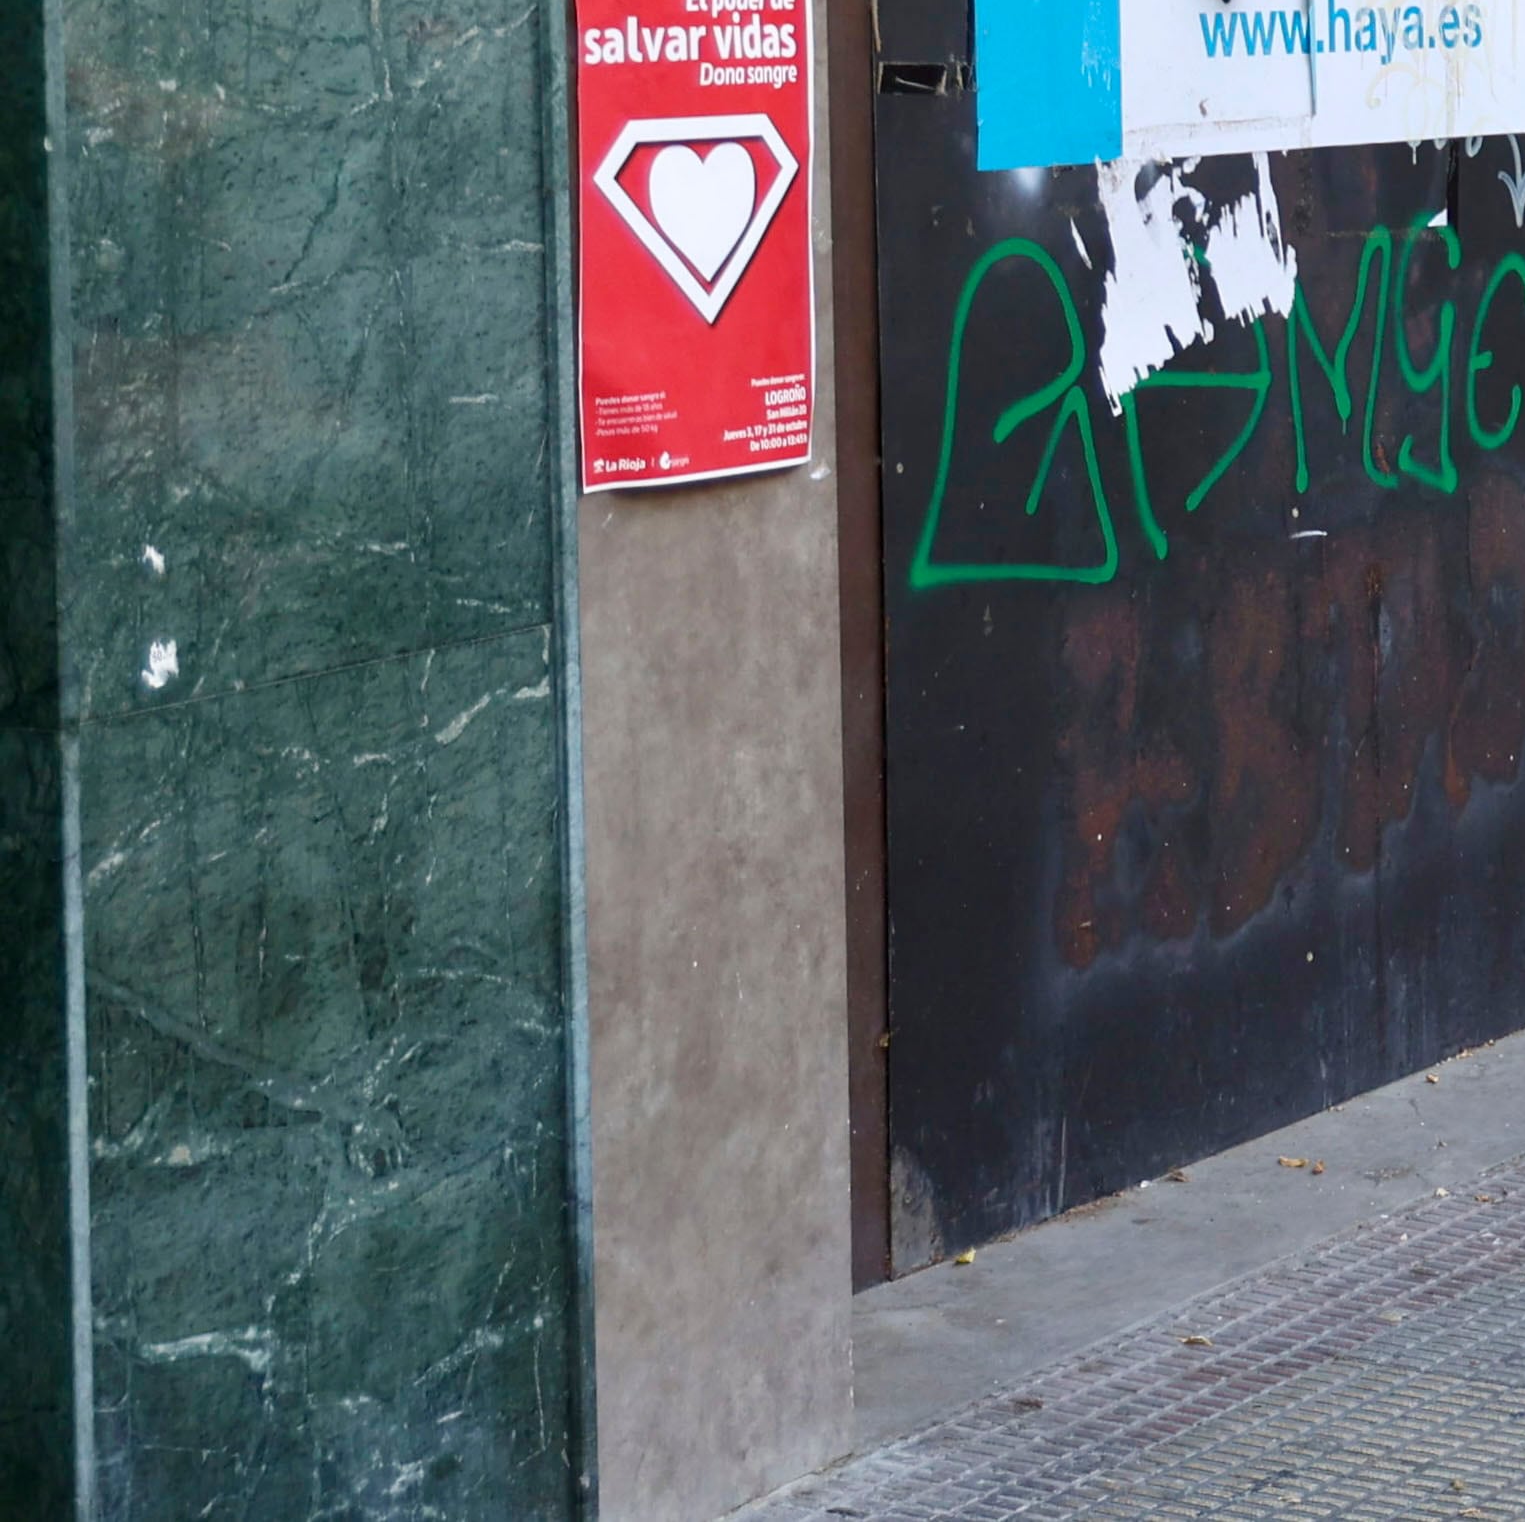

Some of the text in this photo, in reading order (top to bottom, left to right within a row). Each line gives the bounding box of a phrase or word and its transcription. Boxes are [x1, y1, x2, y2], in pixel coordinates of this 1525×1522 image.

[584, 12, 796, 67] salvar vidas
[699, 62, 798, 89] Dona sangre
[595, 395, 620, 407] Puedes
[764, 384, 806, 406] LOGROÑO
[766, 408, 779, 420] San
[723, 427, 747, 442] Jueves
[754, 424, 762, 436] 17
[762, 426, 767, 438] y
[777, 422, 785, 432] de
[786, 419, 808, 432] octubre
[749, 439, 760, 453] De
[760, 436, 782, 451] 10:00
[606, 460, 617, 473] La
[618, 458, 646, 473] Rioja
